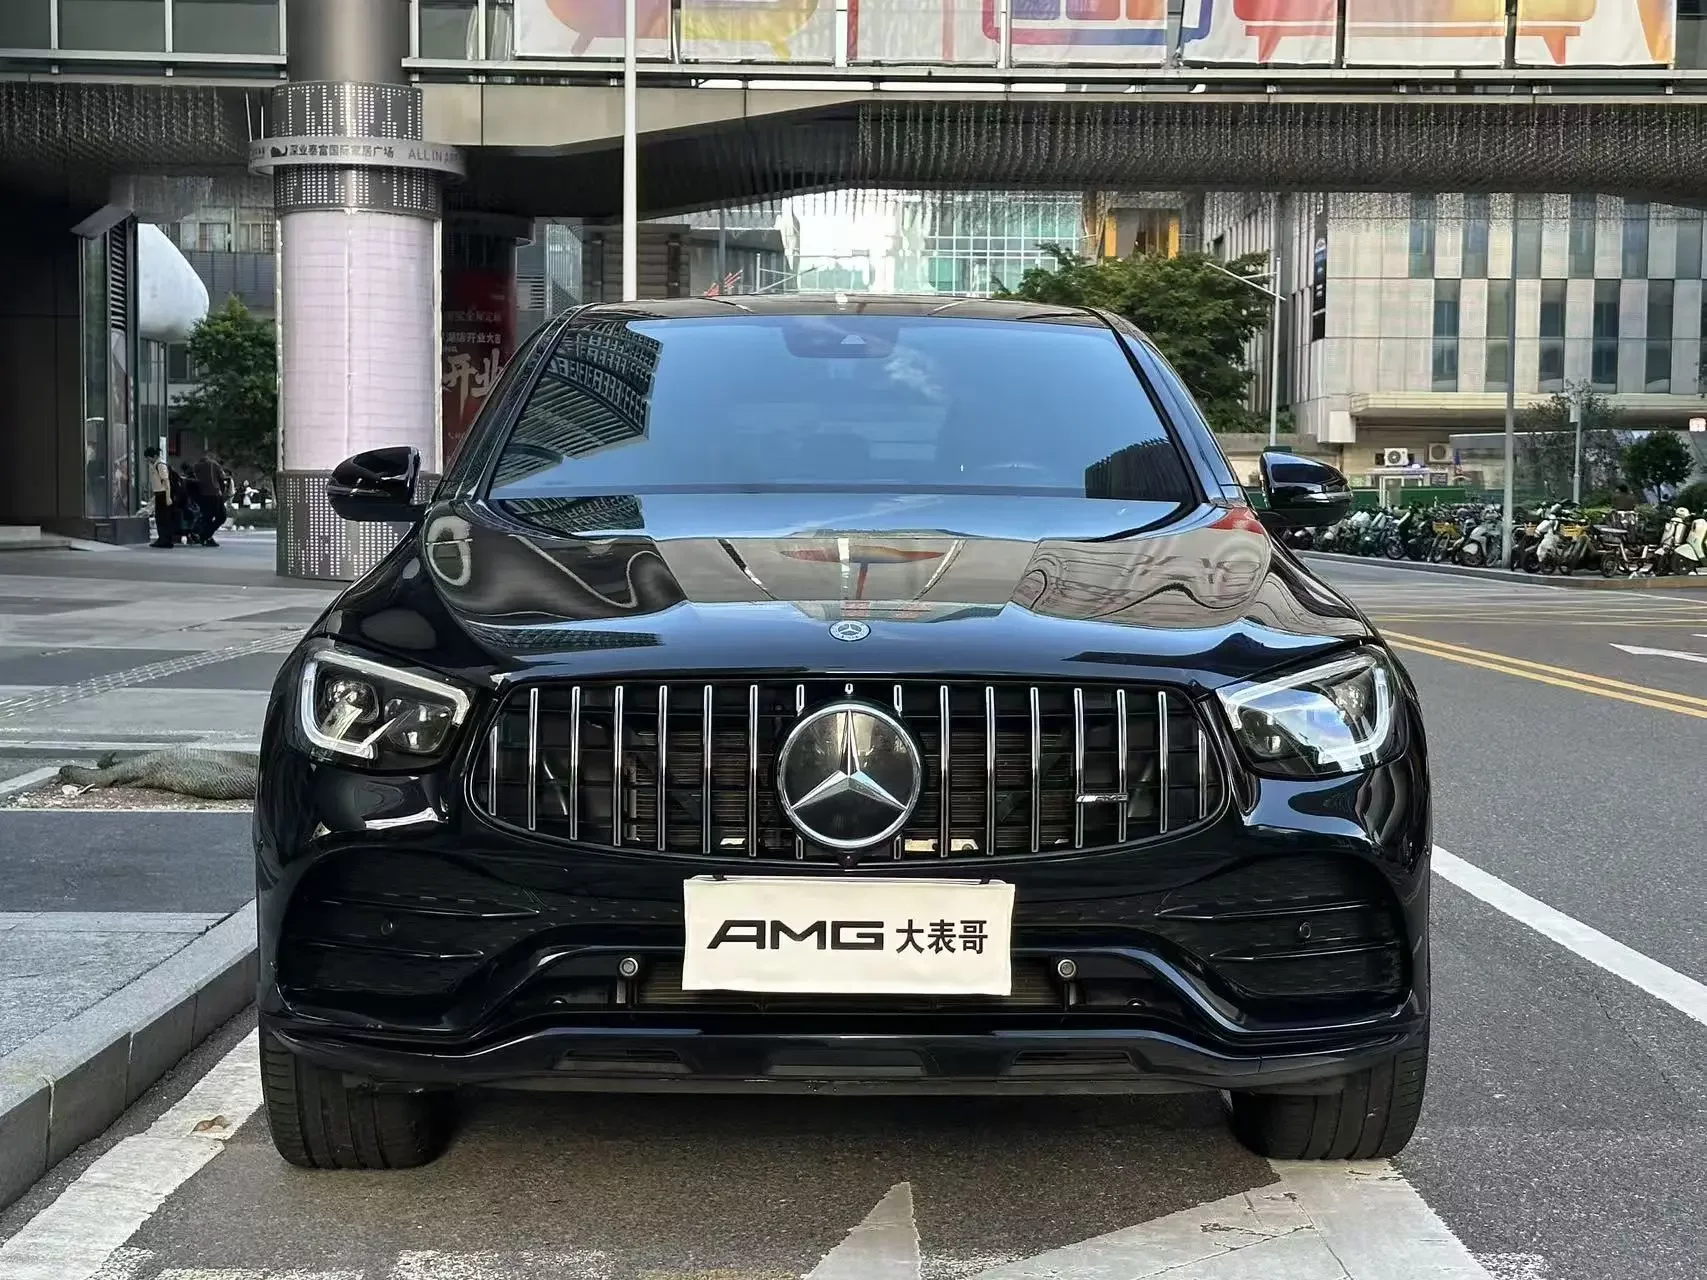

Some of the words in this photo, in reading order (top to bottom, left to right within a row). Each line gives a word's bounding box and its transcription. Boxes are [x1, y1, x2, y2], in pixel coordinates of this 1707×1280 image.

[706, 920, 884, 950] AMG
[895, 918, 989, 954] 大表哥
